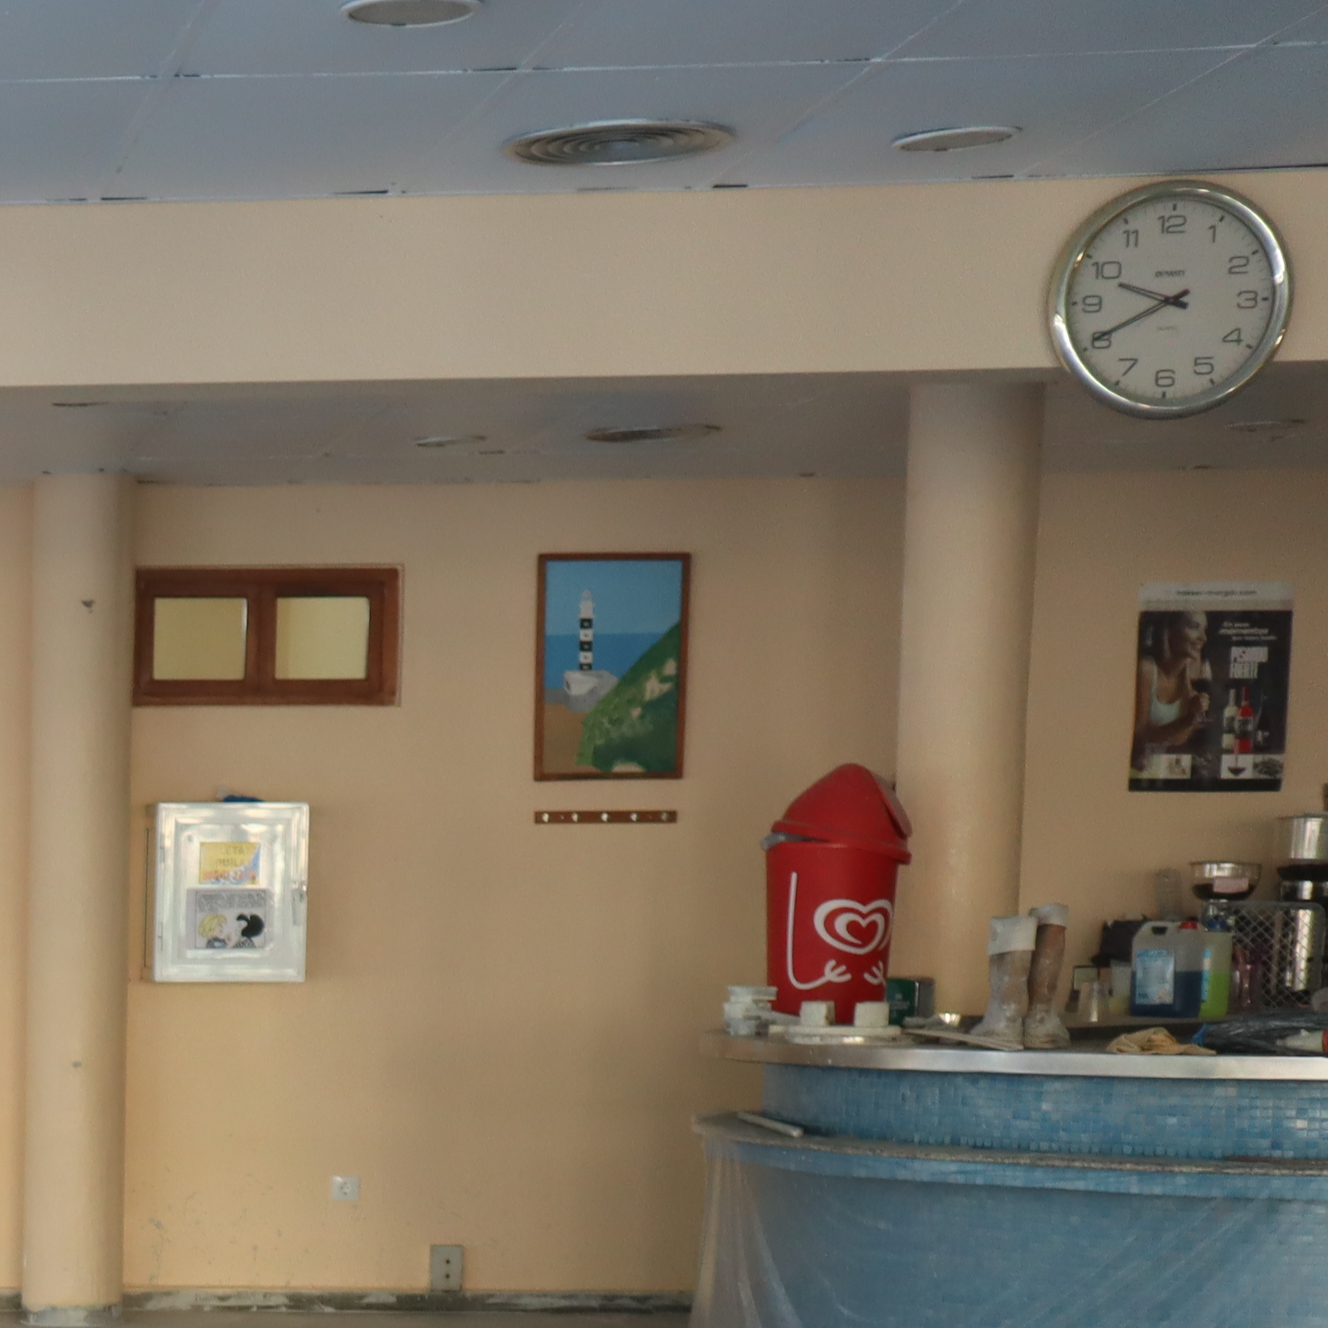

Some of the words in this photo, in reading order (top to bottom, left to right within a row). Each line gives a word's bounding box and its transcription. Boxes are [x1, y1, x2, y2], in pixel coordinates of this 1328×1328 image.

[1158, 215, 1186, 233] 12
[1123, 230, 1138, 247] 11
[1208, 225, 1216, 242] 1
[1092, 261, 1121, 279] 10
[1228, 256, 1248, 273] 2
[1082, 295, 1102, 312] 9
[1237, 290, 1257, 308] 3
[1091, 332, 1111, 349] 8
[1222, 328, 1242, 344] 4
[1119, 357, 1137, 375] 7
[1194, 356, 1214, 374] 5
[1155, 369, 1175, 387] 6
